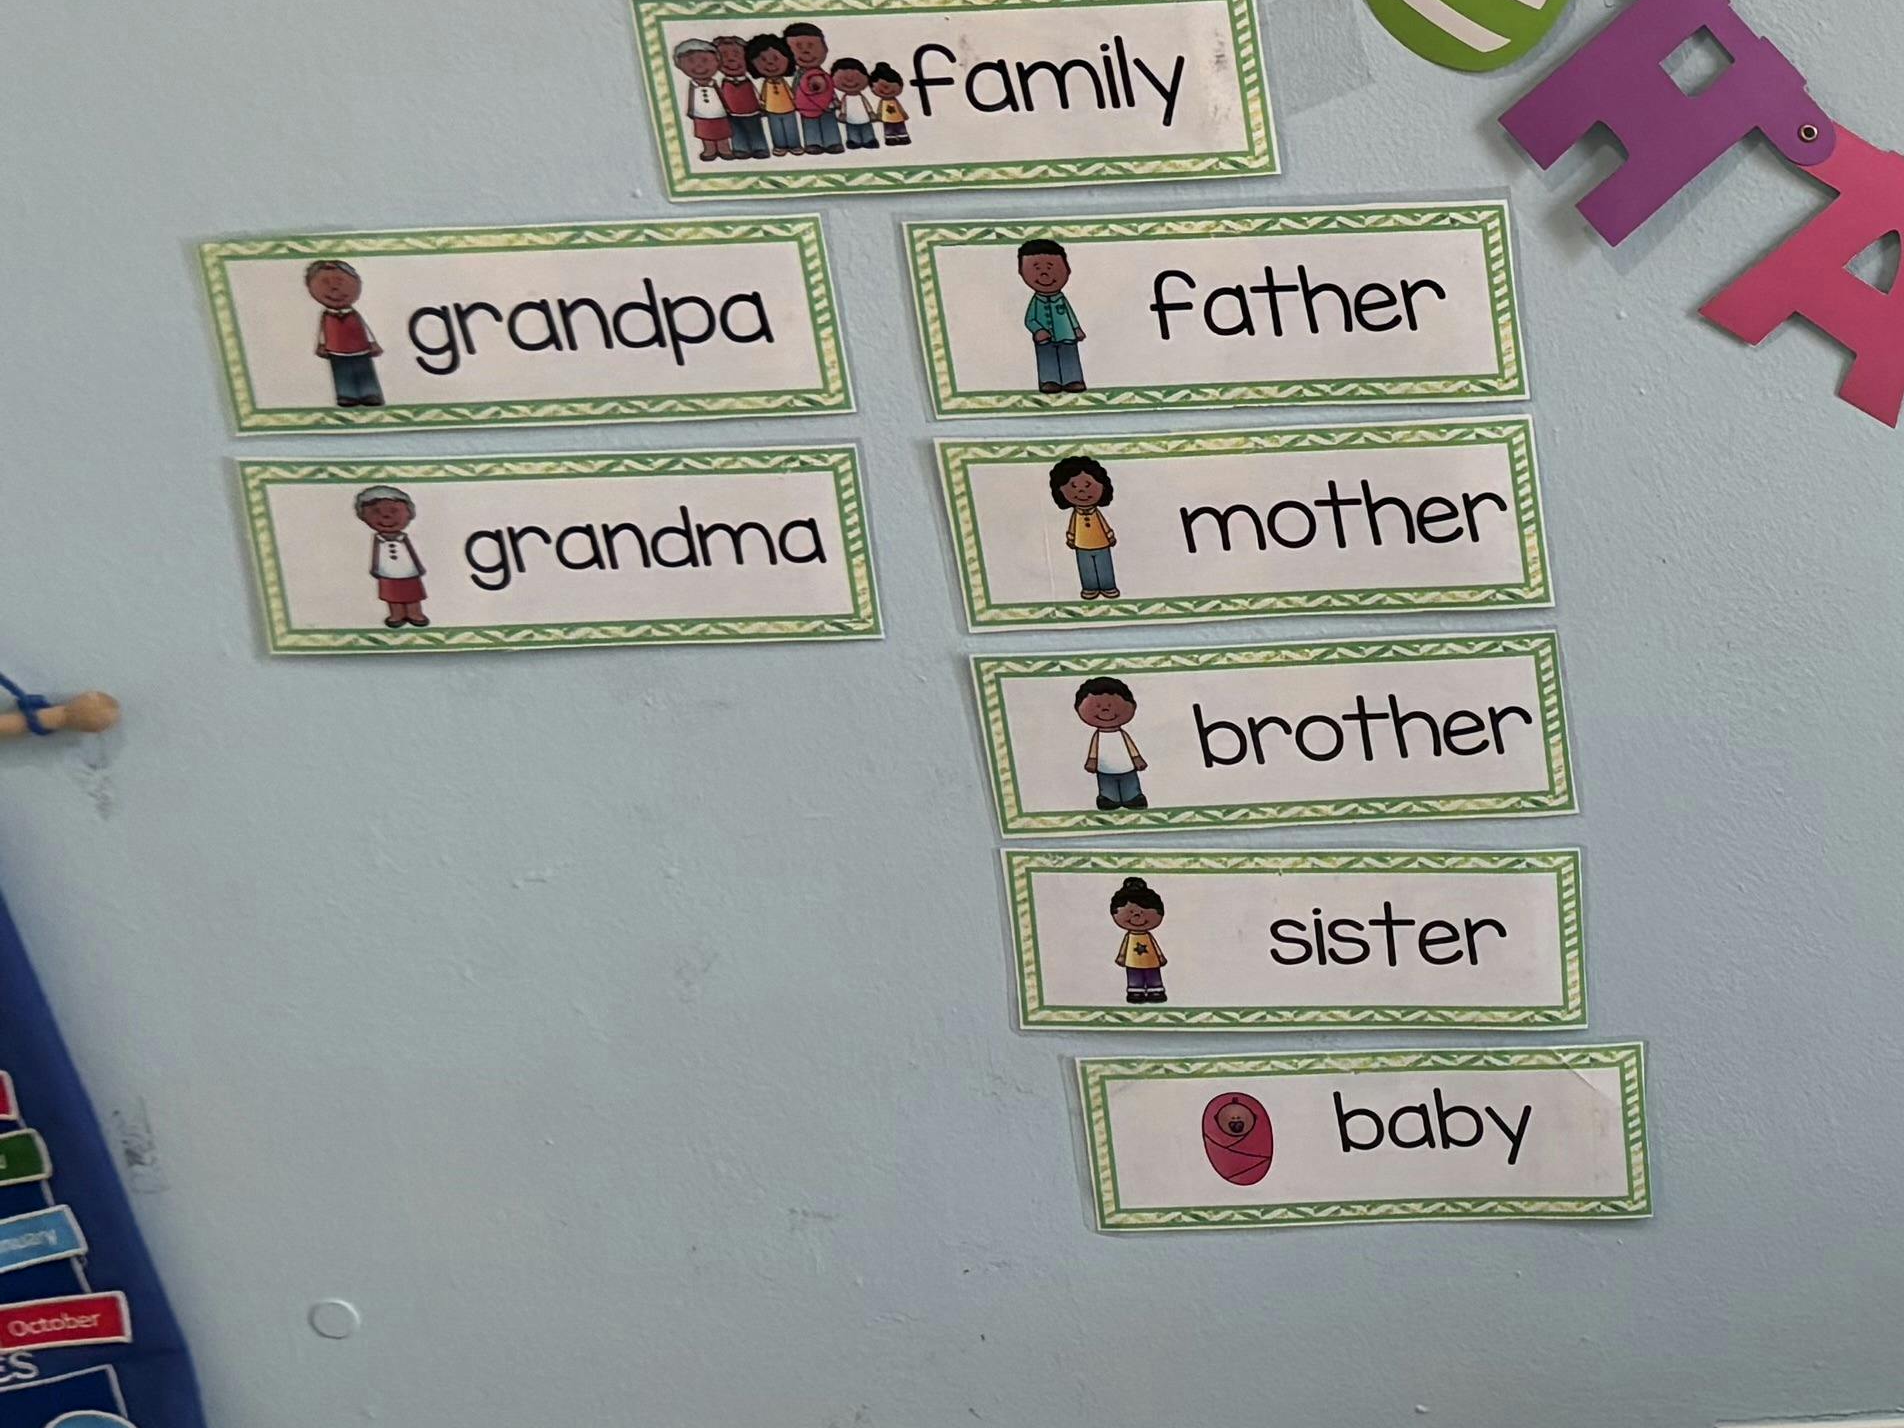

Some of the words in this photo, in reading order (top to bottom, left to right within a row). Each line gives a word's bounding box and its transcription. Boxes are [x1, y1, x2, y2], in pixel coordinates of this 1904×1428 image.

[909, 35, 1186, 127] family
[406, 276, 775, 377] grandpa
[1148, 264, 1447, 342] father
[462, 504, 828, 592] grandma
[1178, 478, 1509, 555] mother
[1191, 692, 1534, 769] brother
[1268, 900, 1508, 968] sister
[1331, 1086, 1533, 1167] baby
[8, 1312, 101, 1338] October
